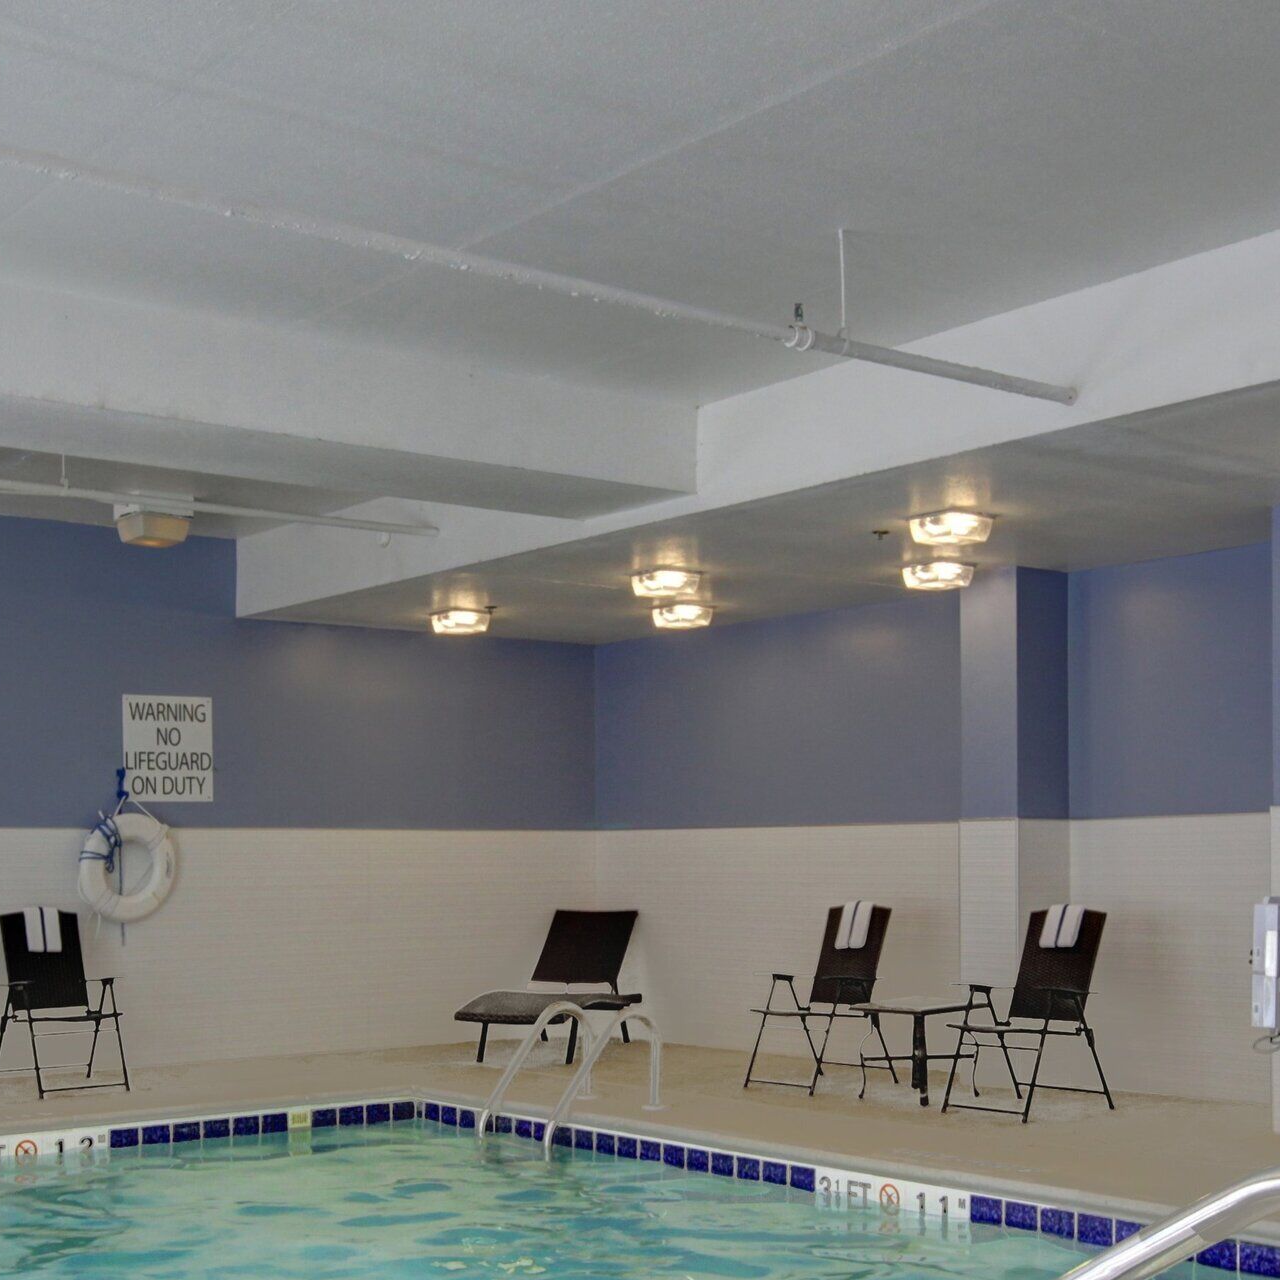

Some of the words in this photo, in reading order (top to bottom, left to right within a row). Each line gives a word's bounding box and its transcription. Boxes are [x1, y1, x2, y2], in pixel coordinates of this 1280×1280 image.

[128, 702, 206, 723] WARNING
[156, 727, 181, 747] NO
[125, 752, 212, 771] LIFEGUARD
[131, 775, 157, 795] ON
[162, 776, 206, 795] DUTY
